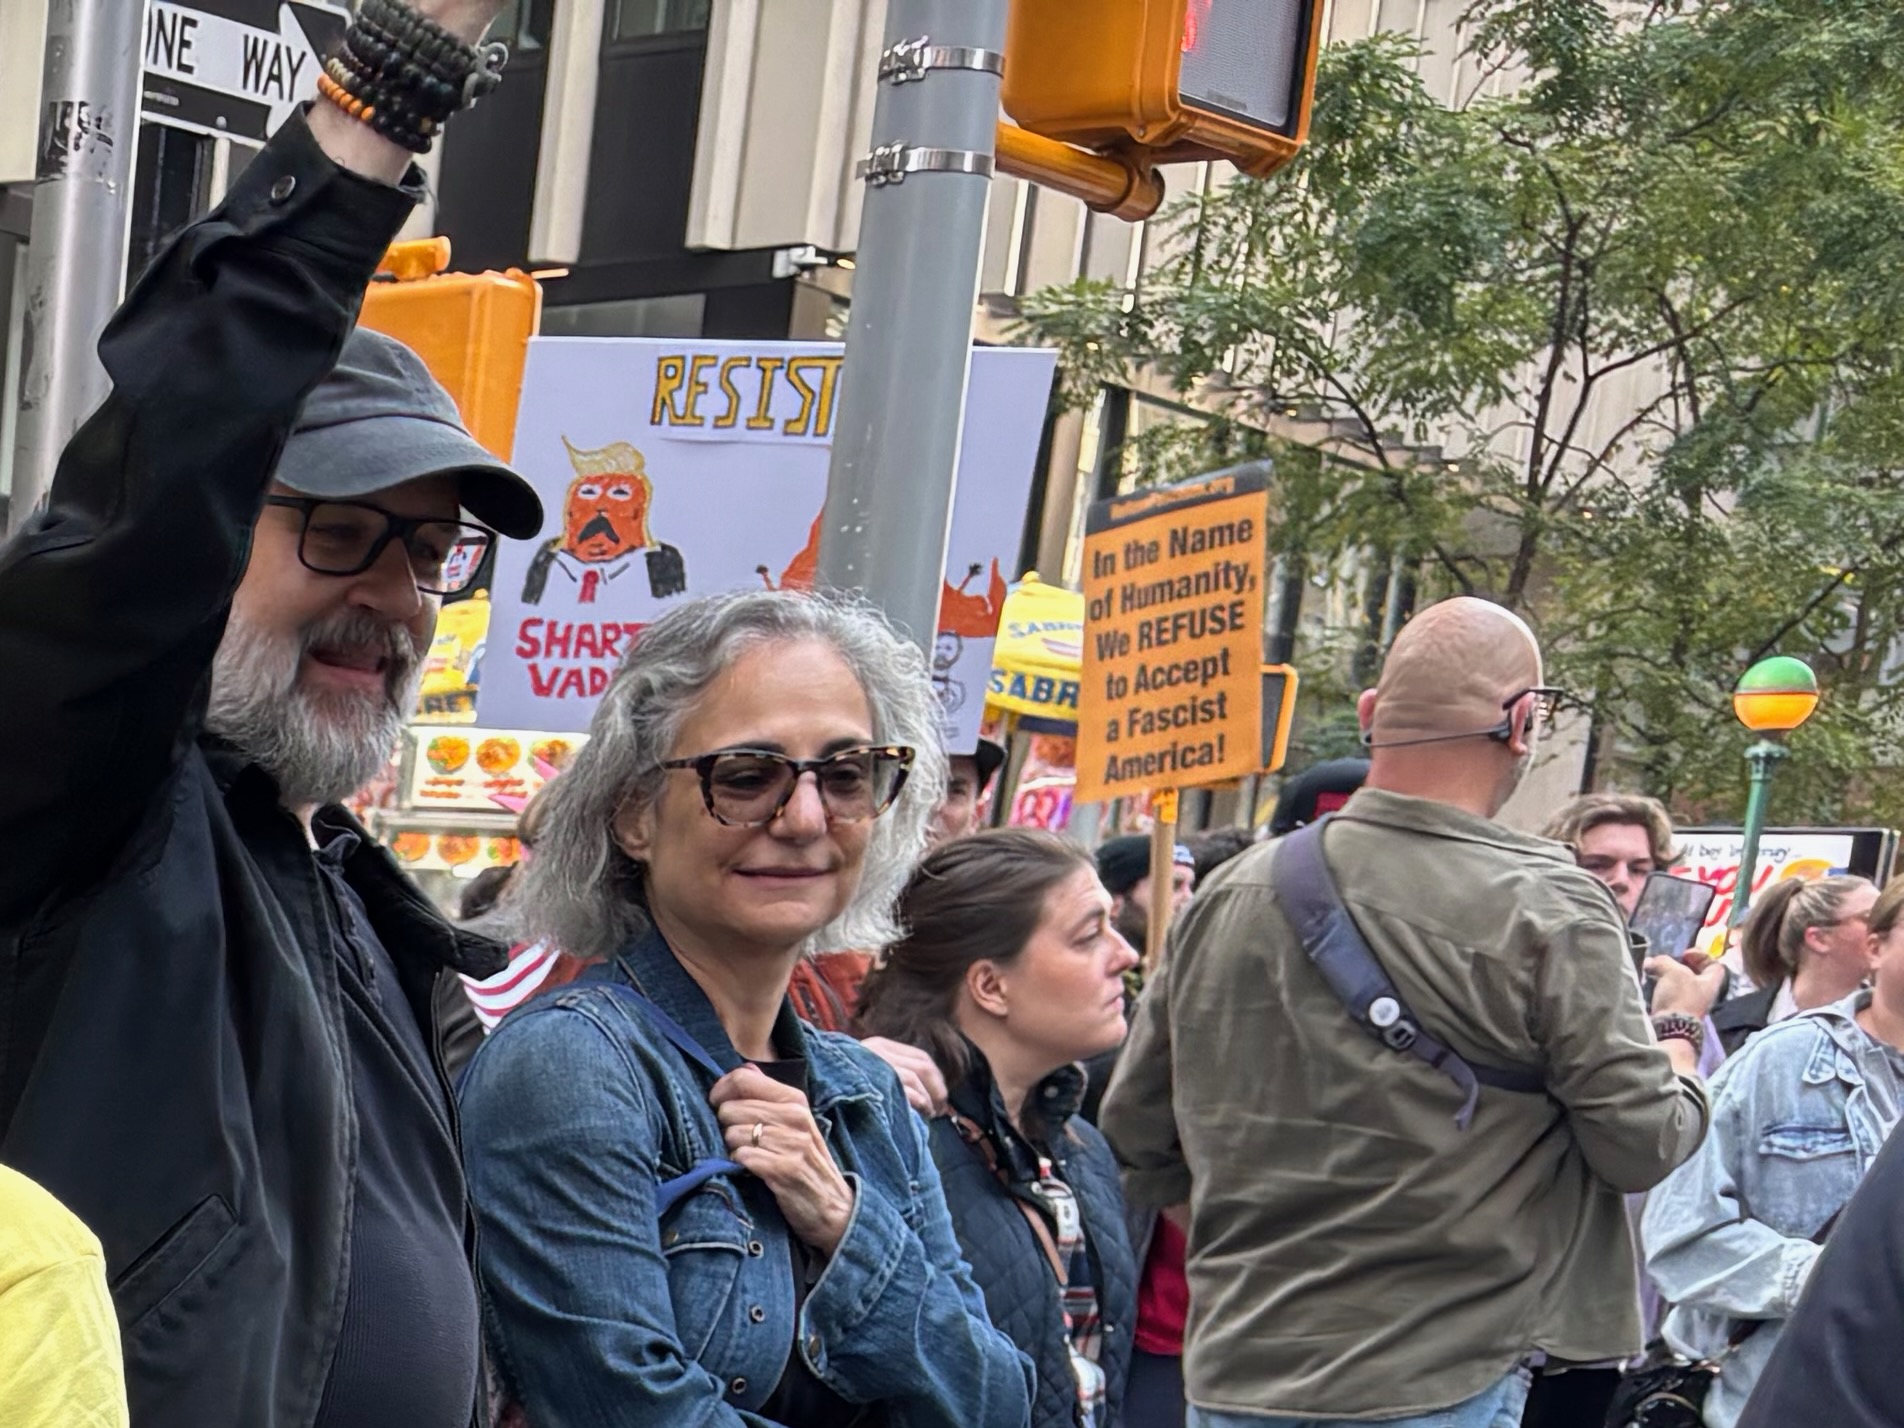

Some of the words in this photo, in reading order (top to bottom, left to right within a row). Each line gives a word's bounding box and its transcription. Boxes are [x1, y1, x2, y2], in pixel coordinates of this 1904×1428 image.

[146, 8, 198, 75] NE
[243, 33, 307, 102] WAY
[650, 355, 845, 437] RESIST
[1094, 549, 1116, 578] In
[1124, 539, 1160, 570] the
[1169, 518, 1253, 558] Name
[1090, 587, 1114, 621] of
[1120, 560, 1256, 613] Humanity,
[1096, 630, 1130, 661] We
[1138, 600, 1245, 651] REFUSE
[527, 663, 622, 698] VAD
[1106, 672, 1128, 701] to
[1134, 647, 1230, 694] Accept
[1106, 718, 1120, 743] a
[1128, 691, 1227, 739] Fascist
[1104, 733, 1225, 785] America!
